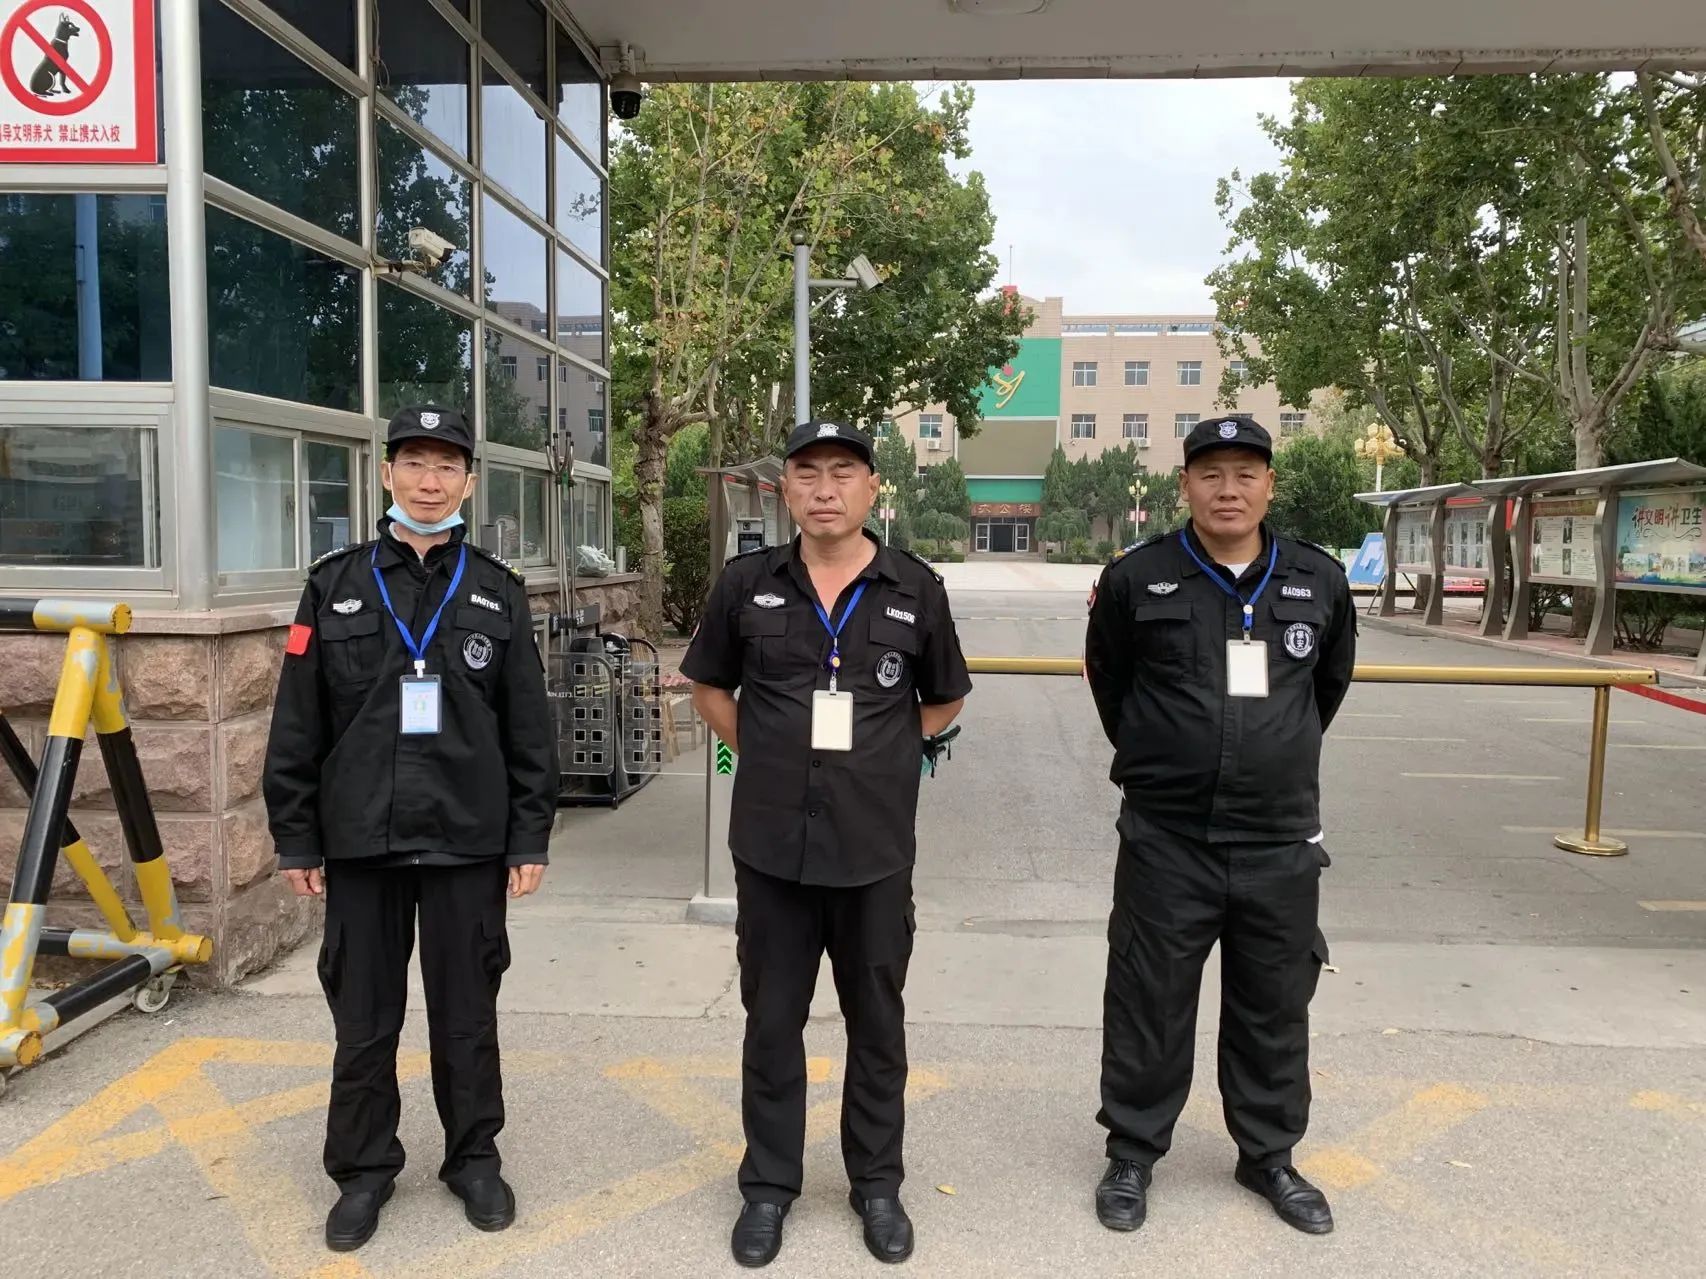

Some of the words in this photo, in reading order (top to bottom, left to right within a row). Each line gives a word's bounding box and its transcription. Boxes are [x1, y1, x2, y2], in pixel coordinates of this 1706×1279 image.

[58, 124, 121, 143] 禁止携犬入校
[1632, 503, 1702, 532] 讲文明讲卫生
